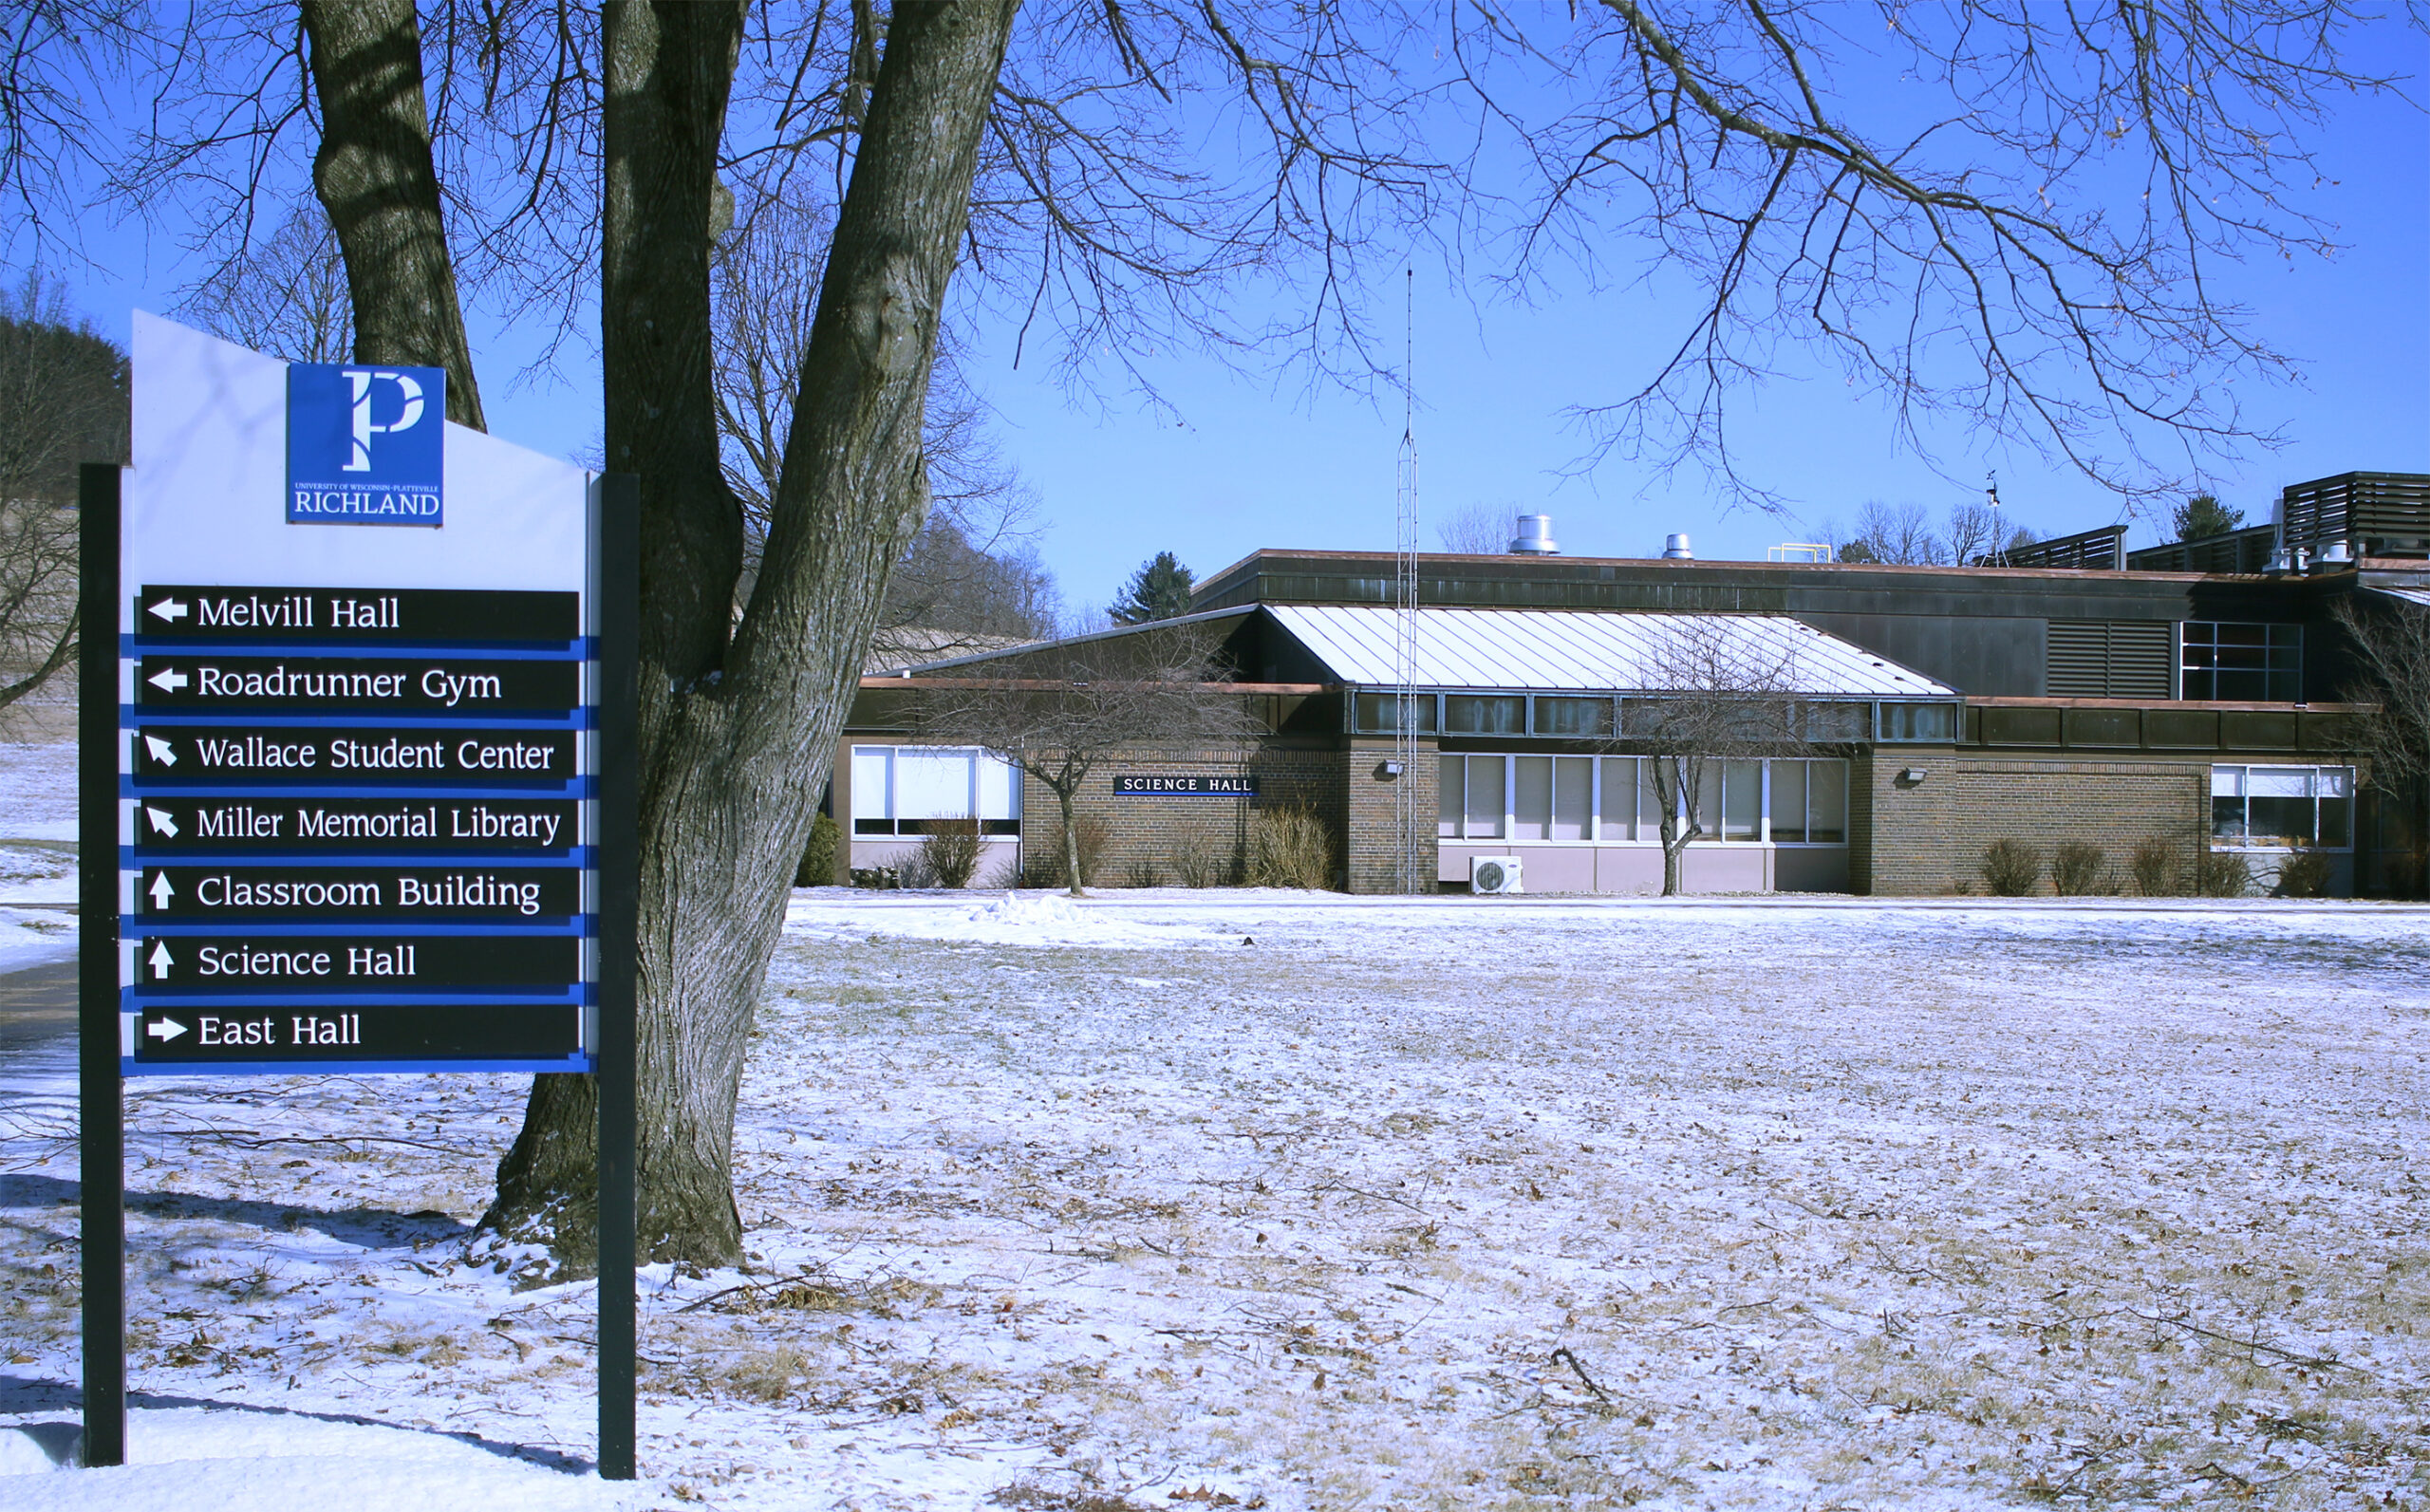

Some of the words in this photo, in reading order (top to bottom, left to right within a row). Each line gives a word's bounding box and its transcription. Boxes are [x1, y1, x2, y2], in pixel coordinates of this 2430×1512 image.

[294, 491, 439, 515] RICHLAND
[197, 596, 313, 627] Melvill
[330, 598, 400, 628] Hall
[197, 666, 406, 698] Roadrunner
[421, 670, 501, 707] Gym
[196, 737, 316, 768] Wallace
[330, 738, 445, 769] Student
[458, 741, 554, 770] Center
[1124, 778, 1198, 791] SCIENCE
[1209, 779, 1252, 792] HALL
[197, 807, 284, 837] Miller
[297, 807, 437, 837] Memorial
[451, 807, 561, 847] Library
[197, 876, 382, 906] Classroom
[398, 876, 540, 915] Building
[198, 945, 330, 976] Science
[347, 945, 416, 976] Hall
[198, 1016, 275, 1045] East
[291, 1014, 361, 1045] Hall
